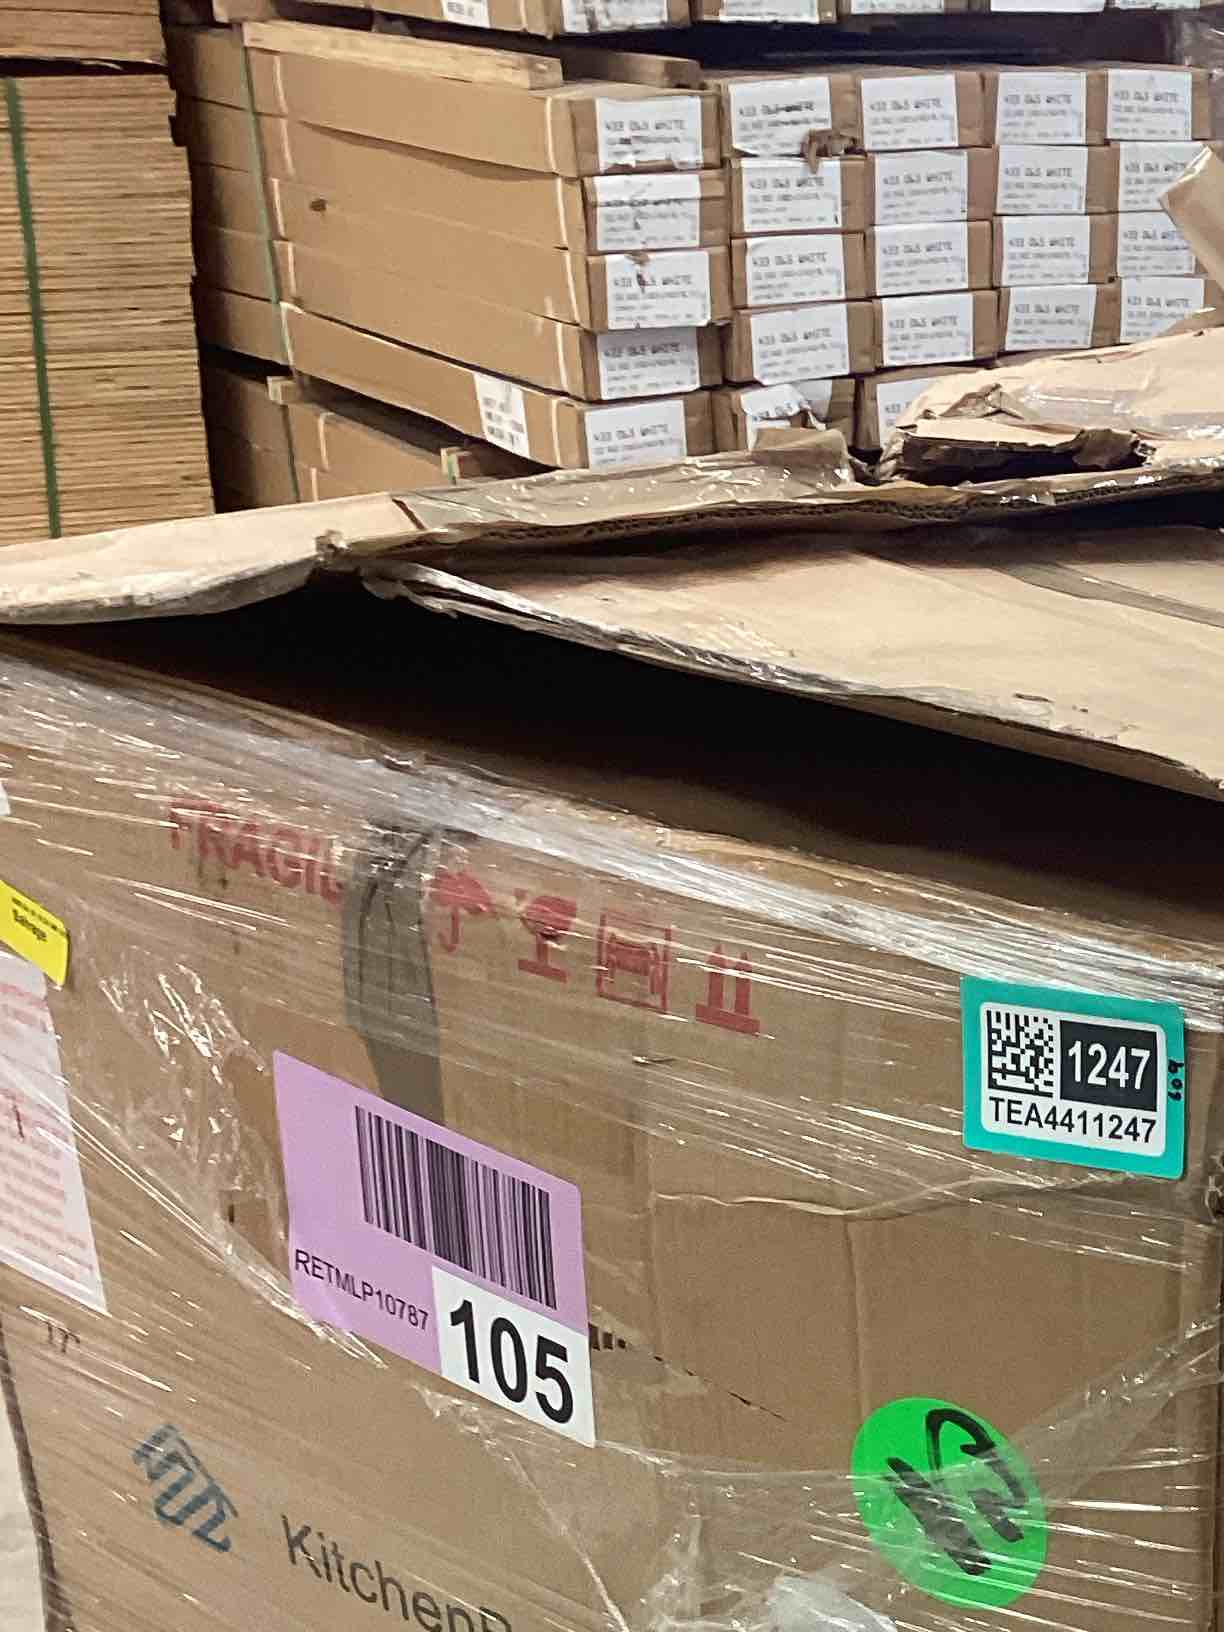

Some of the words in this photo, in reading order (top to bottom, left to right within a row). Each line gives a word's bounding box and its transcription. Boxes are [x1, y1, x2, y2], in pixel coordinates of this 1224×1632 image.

[1068, 1040, 1151, 1090] 1247
[989, 1096, 1157, 1143] TEA4411247
[294, 1249, 430, 1332] RETMLP10787
[449, 1299, 574, 1425] 105
